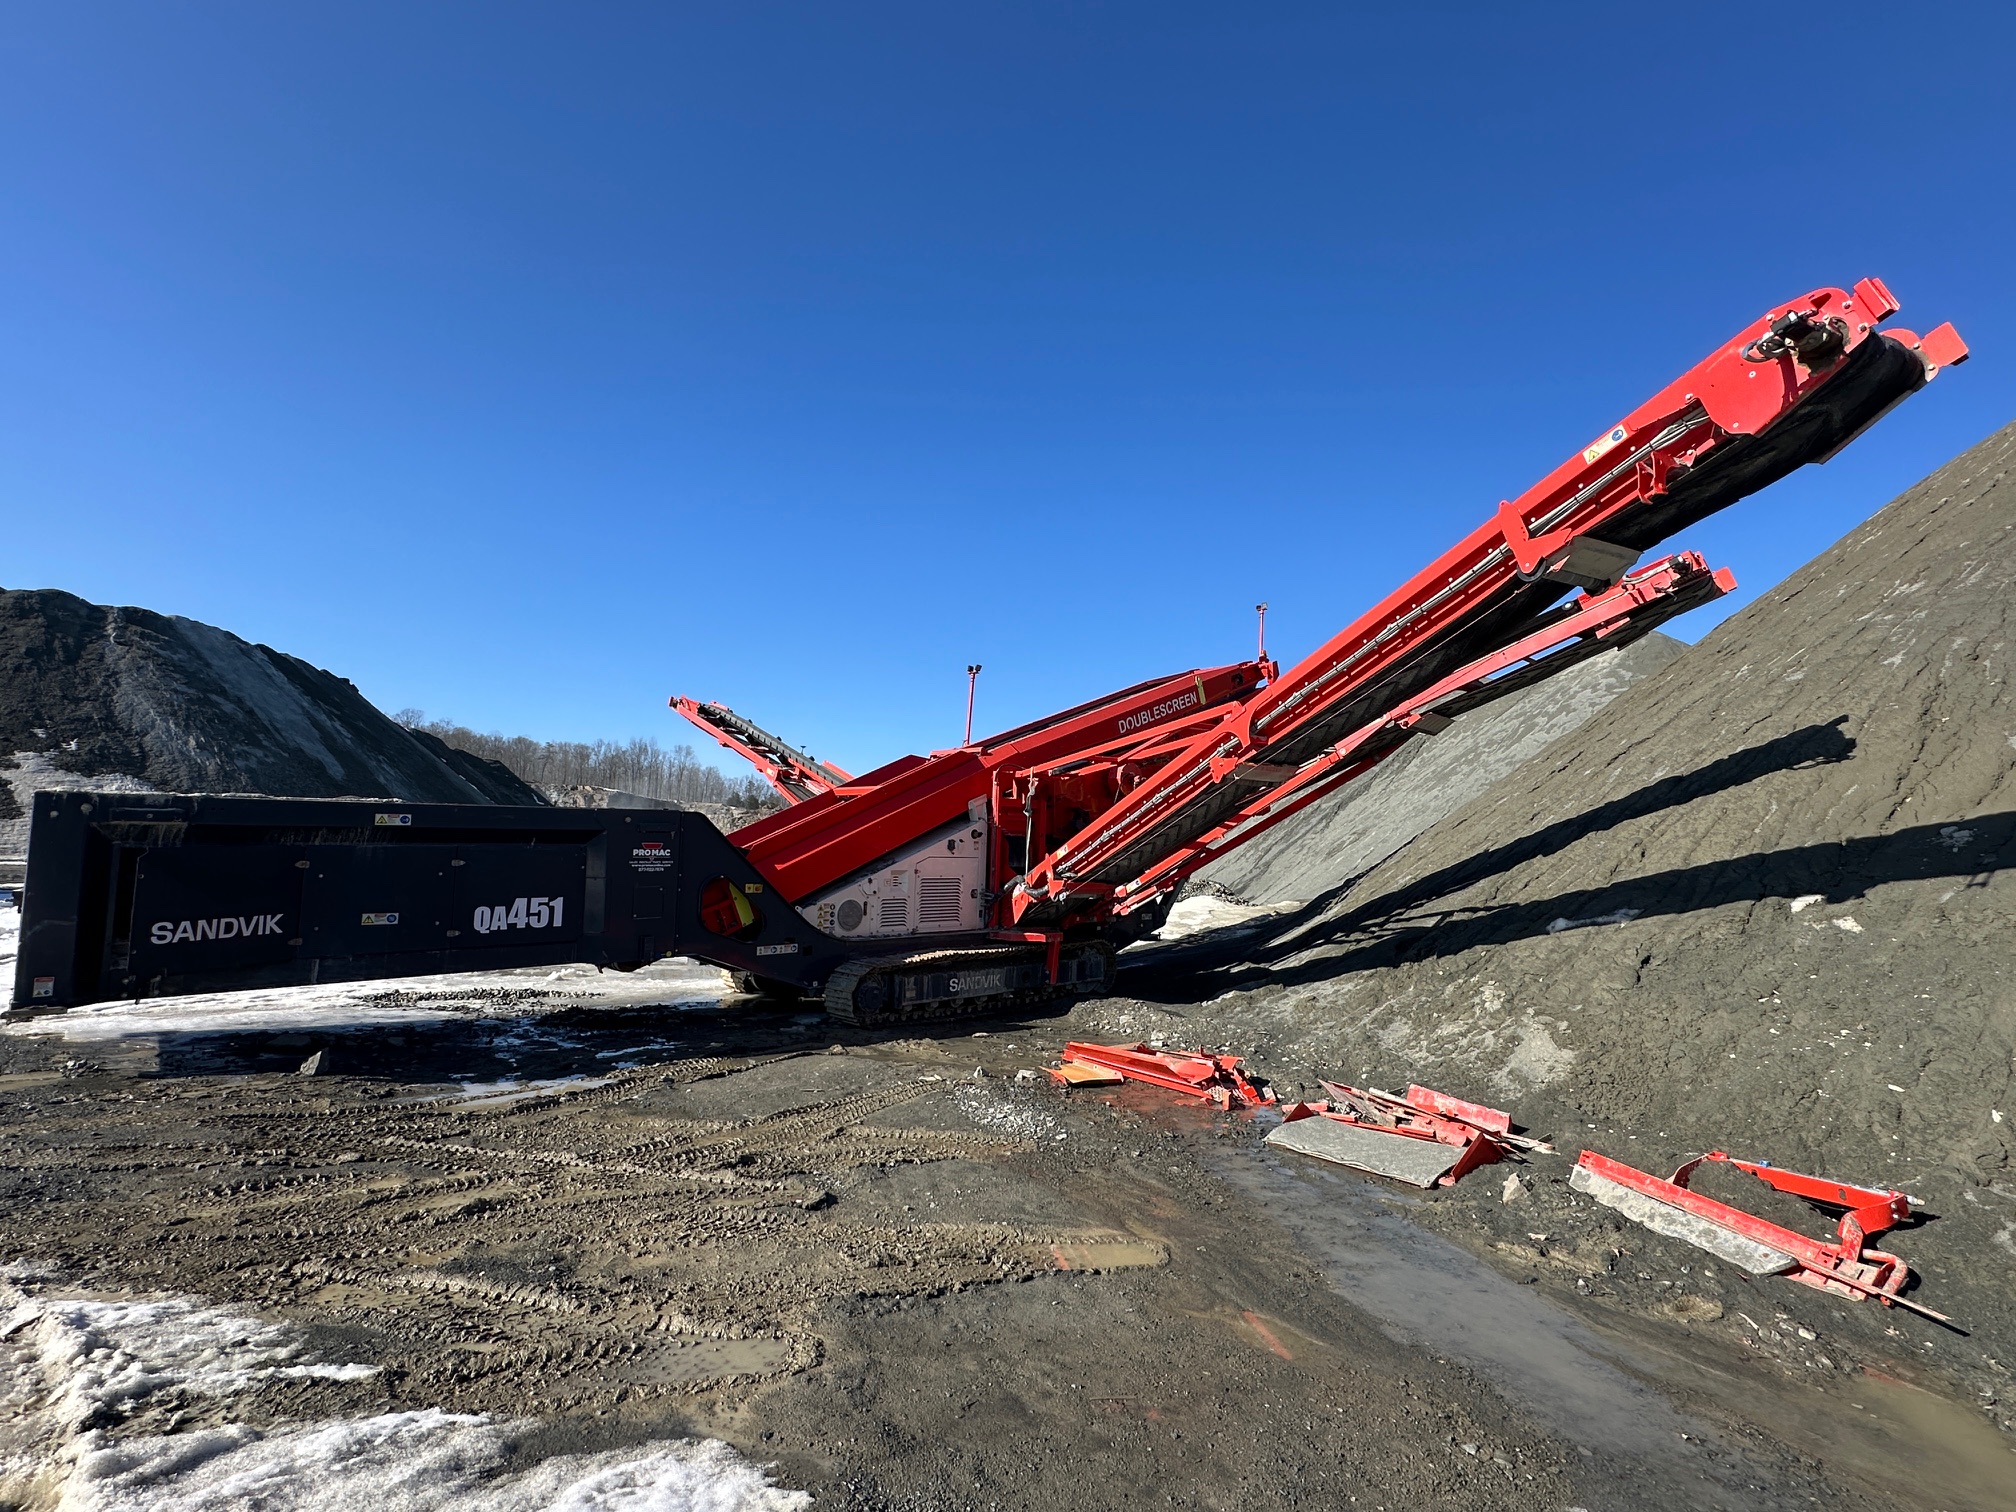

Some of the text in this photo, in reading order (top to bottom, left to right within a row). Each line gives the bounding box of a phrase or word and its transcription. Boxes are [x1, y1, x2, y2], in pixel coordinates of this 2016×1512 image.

[1118, 691, 1198, 734] DOUBLESCREEN
[150, 913, 284, 945] SANDVIK
[473, 896, 564, 934] QA451
[949, 974, 1002, 992] SANDVIK
